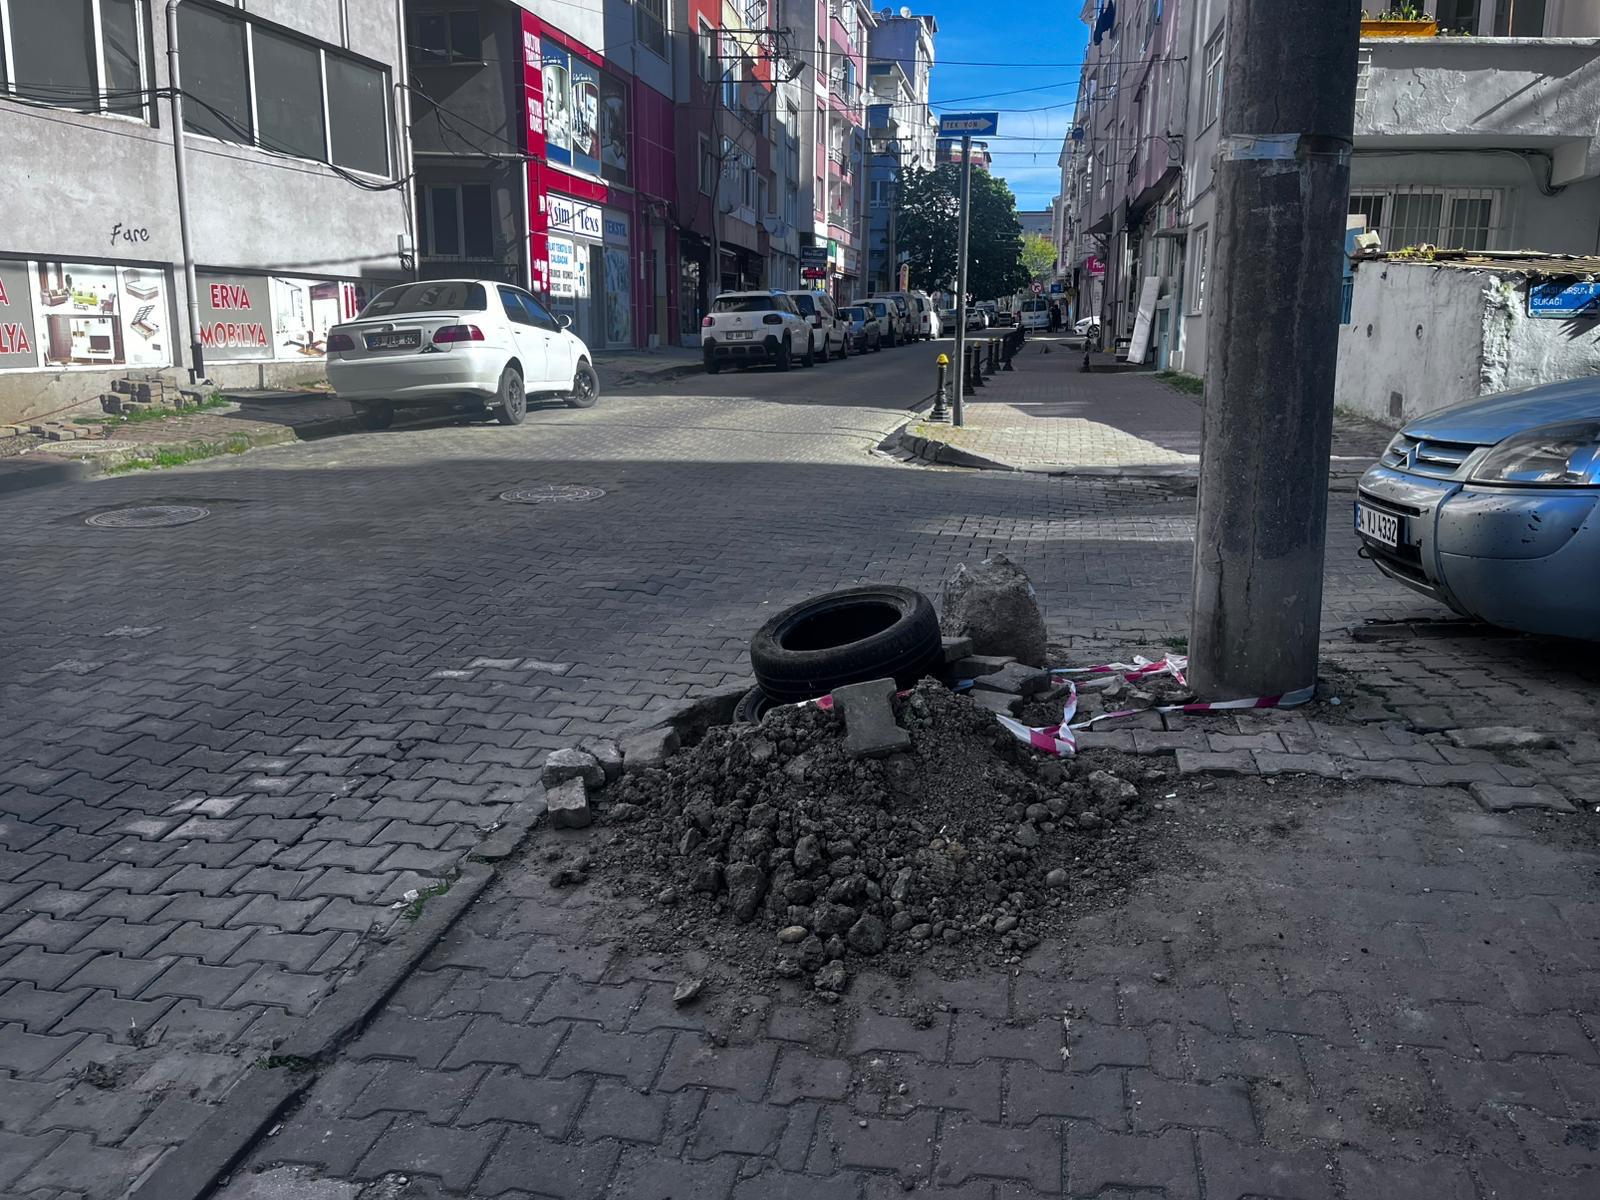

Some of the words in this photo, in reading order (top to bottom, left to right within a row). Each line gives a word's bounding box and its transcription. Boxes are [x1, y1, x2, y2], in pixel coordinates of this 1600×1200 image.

[110, 222, 149, 246] Fare
[210, 282, 252, 311] ERVA
[1378, 514, 1396, 543] 4332
